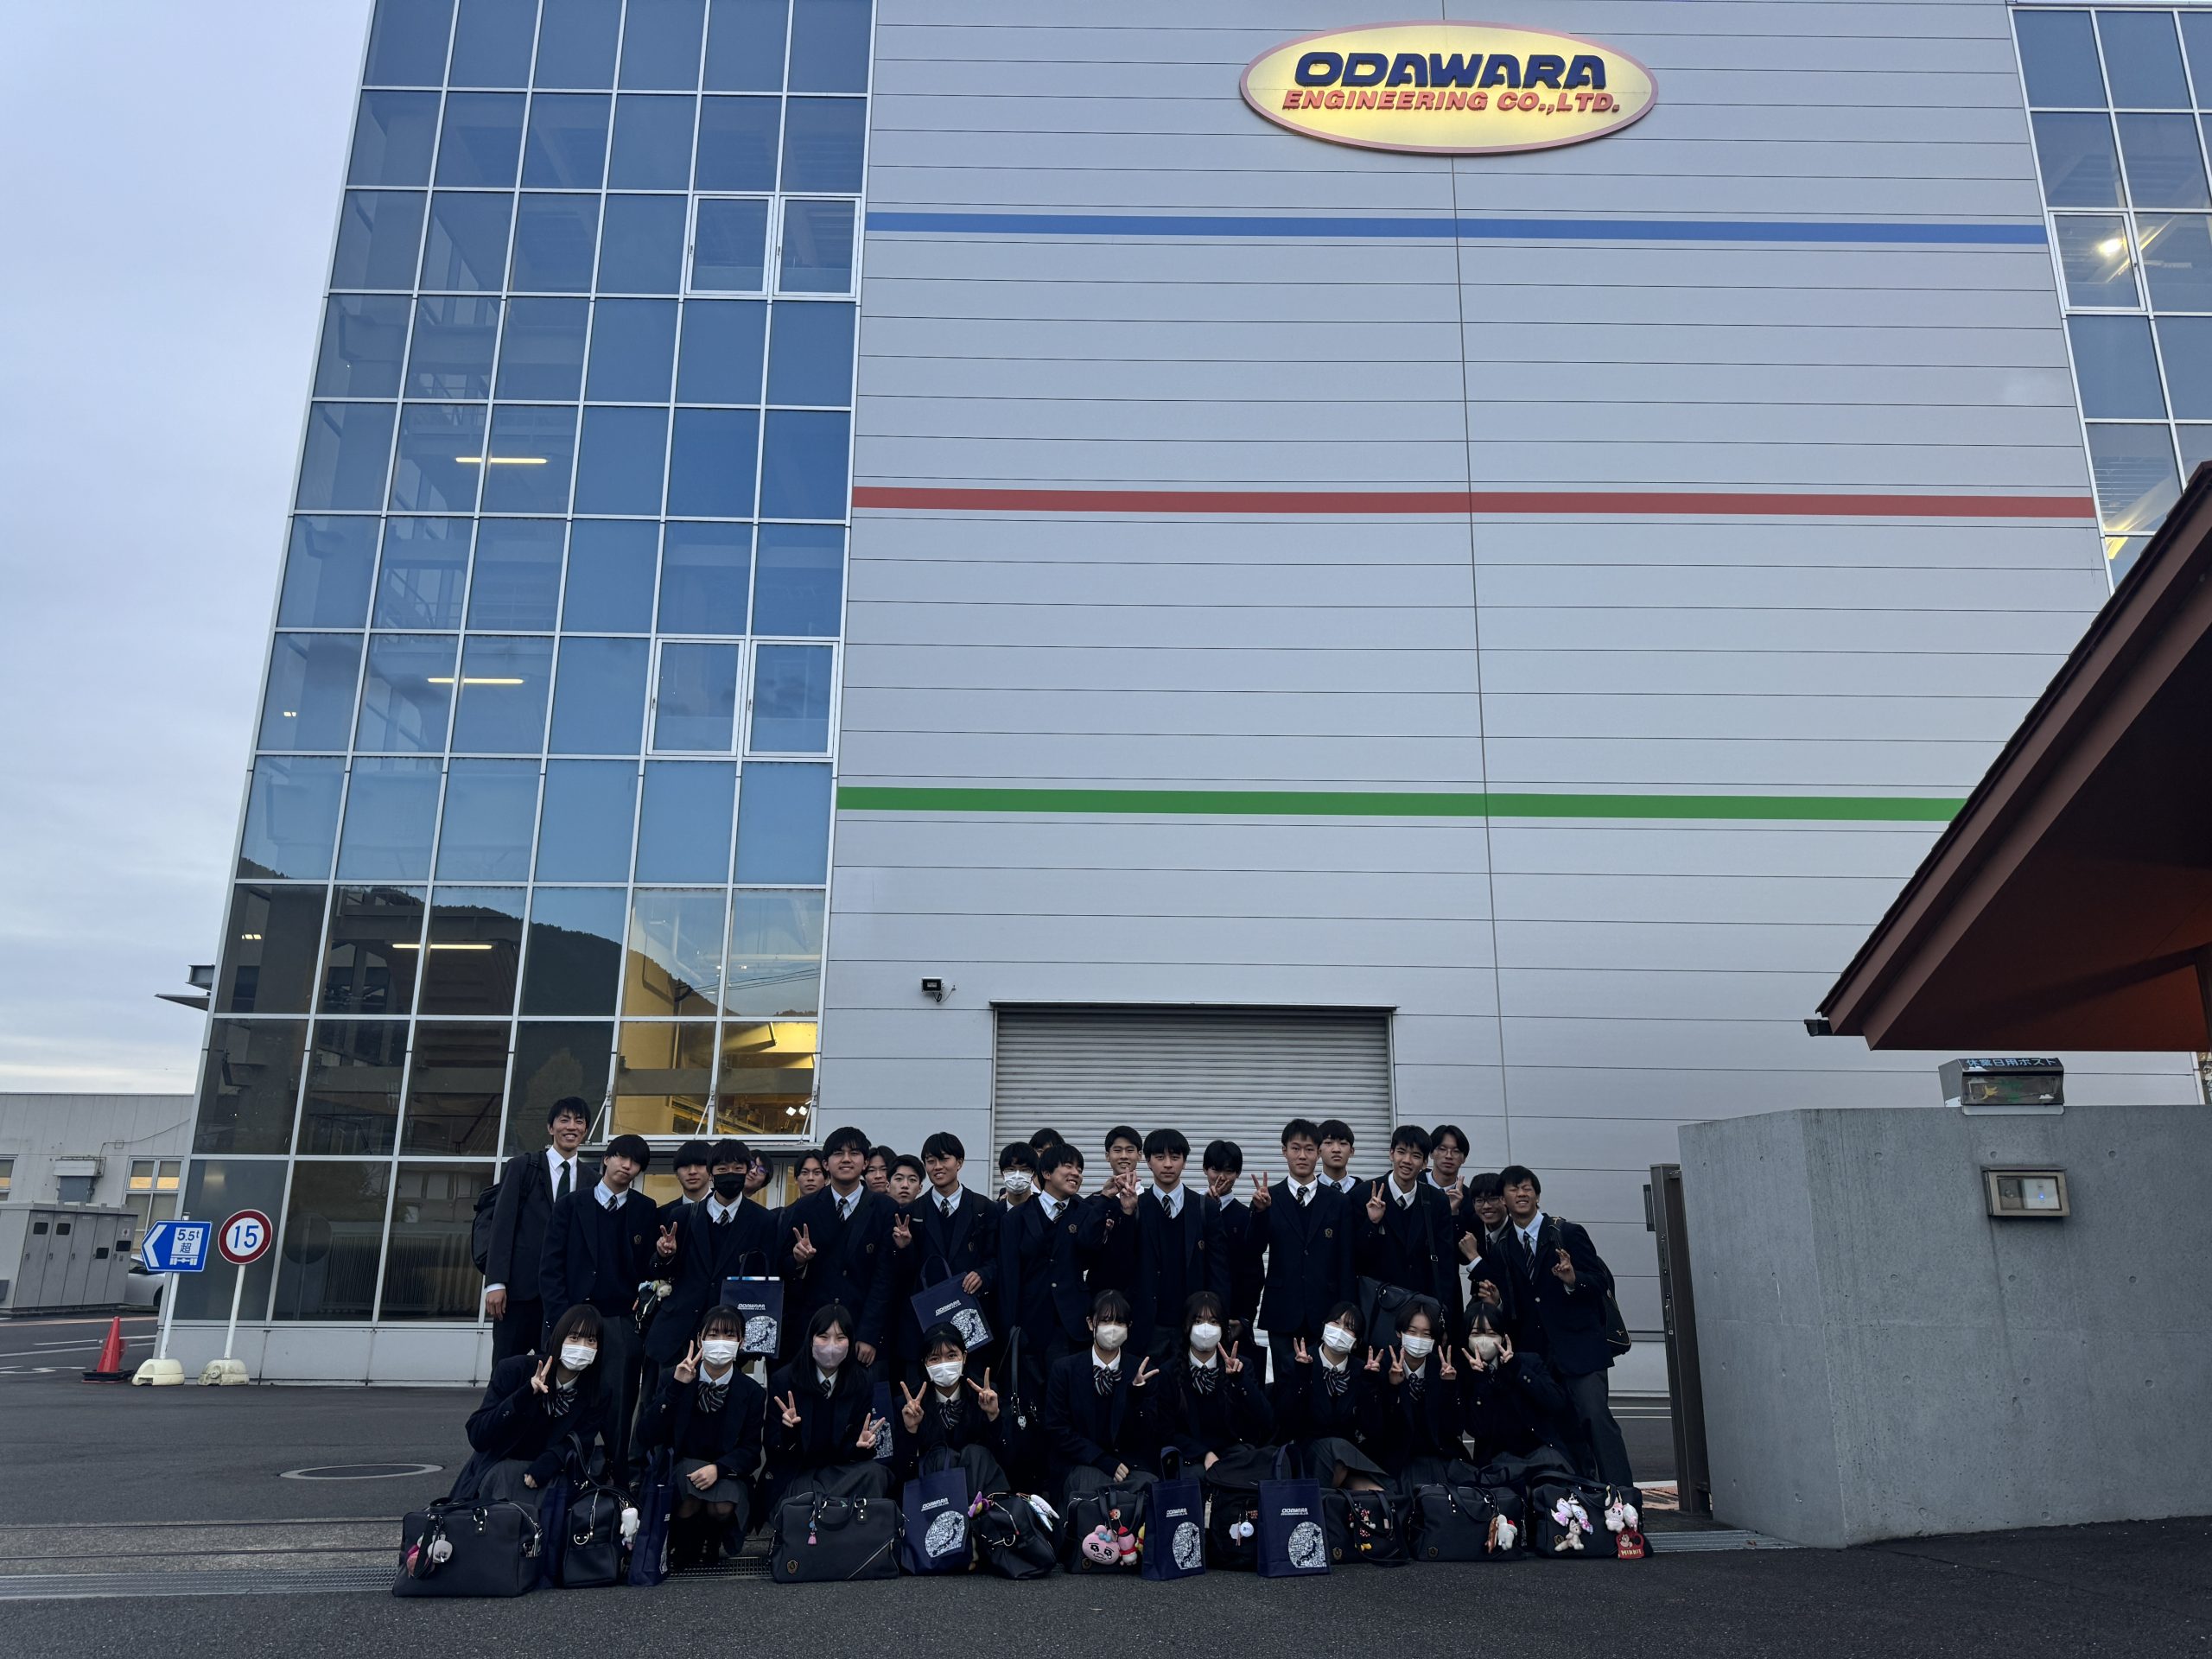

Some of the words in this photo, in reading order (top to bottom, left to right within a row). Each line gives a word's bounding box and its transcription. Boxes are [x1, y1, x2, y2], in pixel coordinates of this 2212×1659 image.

[1294, 52, 1606, 90] ODAWARA
[1282, 89, 1488, 111] ENGINEERING
[1967, 1058, 2056, 1067] 休業日用ポスト
[233, 1224, 259, 1249] 15
[180, 1243, 192, 1253] 超
